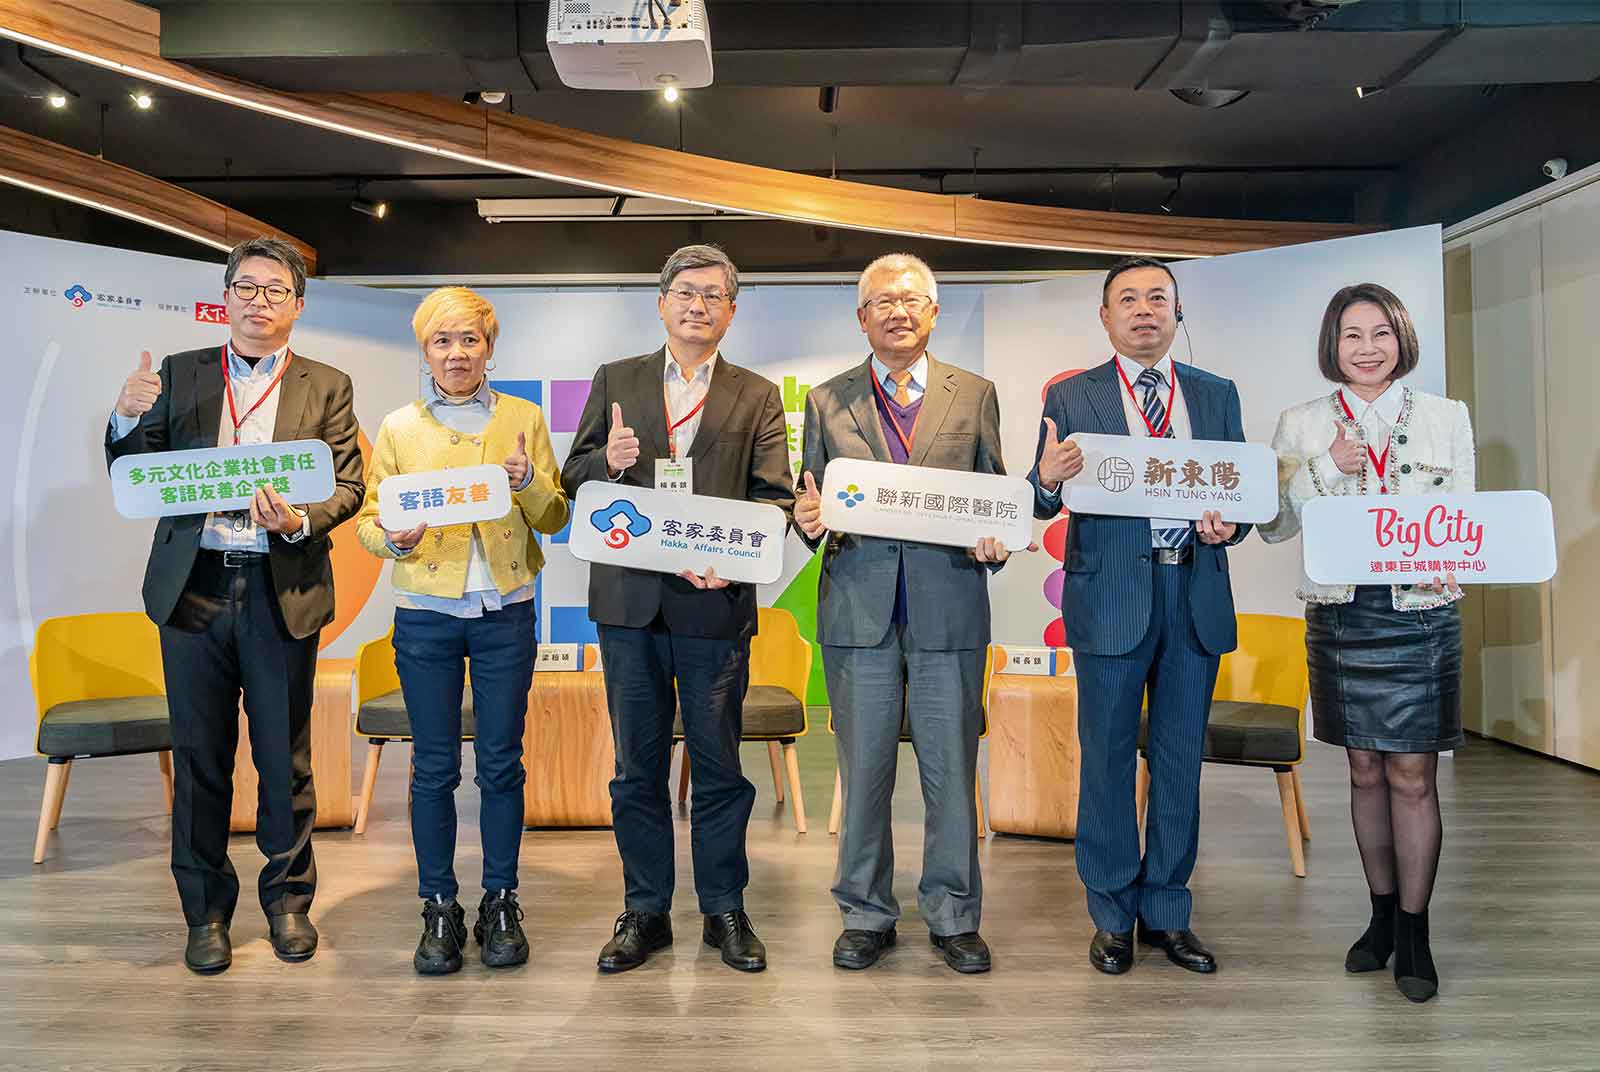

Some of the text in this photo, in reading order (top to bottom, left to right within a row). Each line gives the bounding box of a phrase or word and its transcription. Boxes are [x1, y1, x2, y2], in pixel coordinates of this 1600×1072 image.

[128, 452, 315, 486] 多元文化企業社會責任
[1143, 456, 1241, 491] 新東陽
[399, 481, 490, 511] 客語友善
[875, 487, 1019, 520] 聯新國際醫院
[1144, 488, 1243, 502] HSIN TUNG YANG
[661, 519, 768, 548] 客家委員會
[660, 538, 762, 559] Hakka Affairs Council
[1369, 559, 1488, 573] 遠東巨城購物中心
